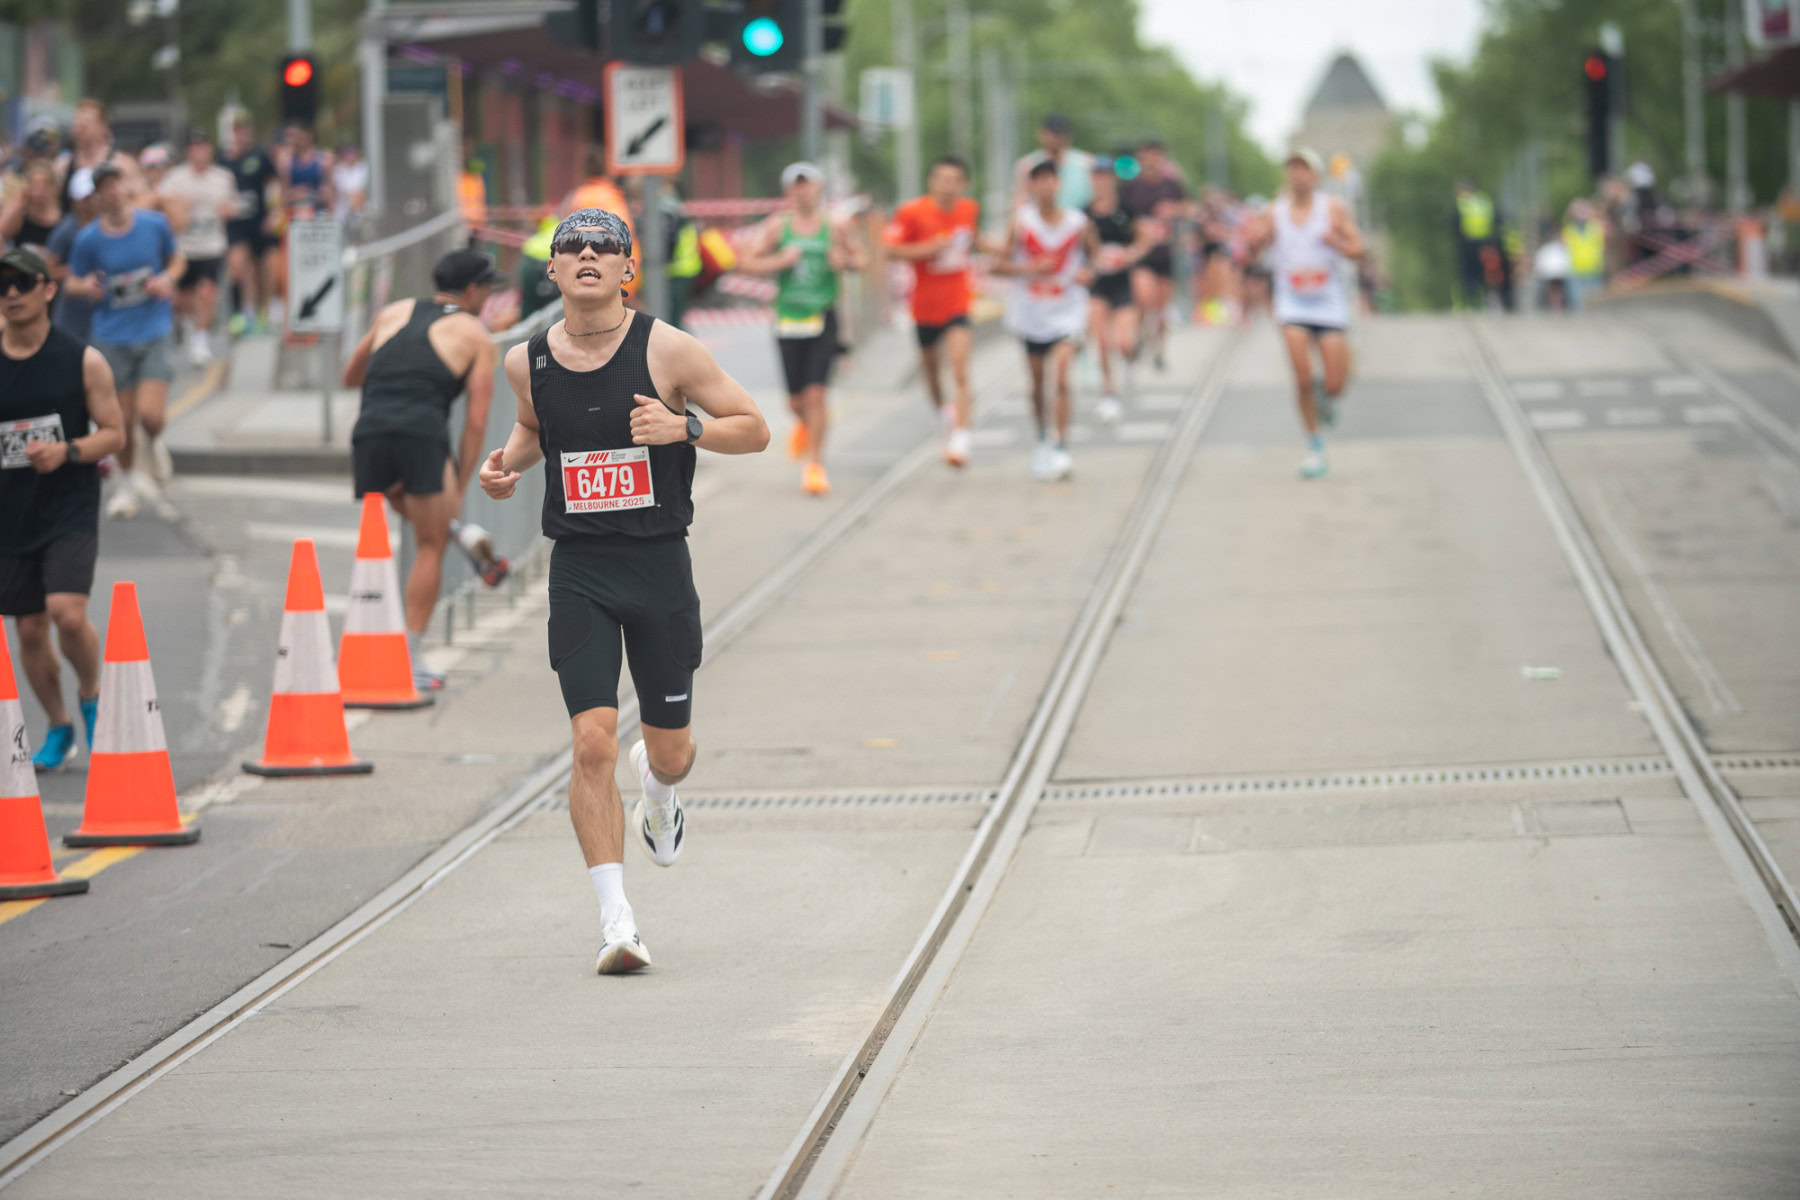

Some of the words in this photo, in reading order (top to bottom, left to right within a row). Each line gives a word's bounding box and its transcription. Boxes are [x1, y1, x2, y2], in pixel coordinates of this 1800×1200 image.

[577, 465, 635, 499] 6479
[573, 499, 620, 511] MELBOURNE
[622, 497, 645, 507] 2025
